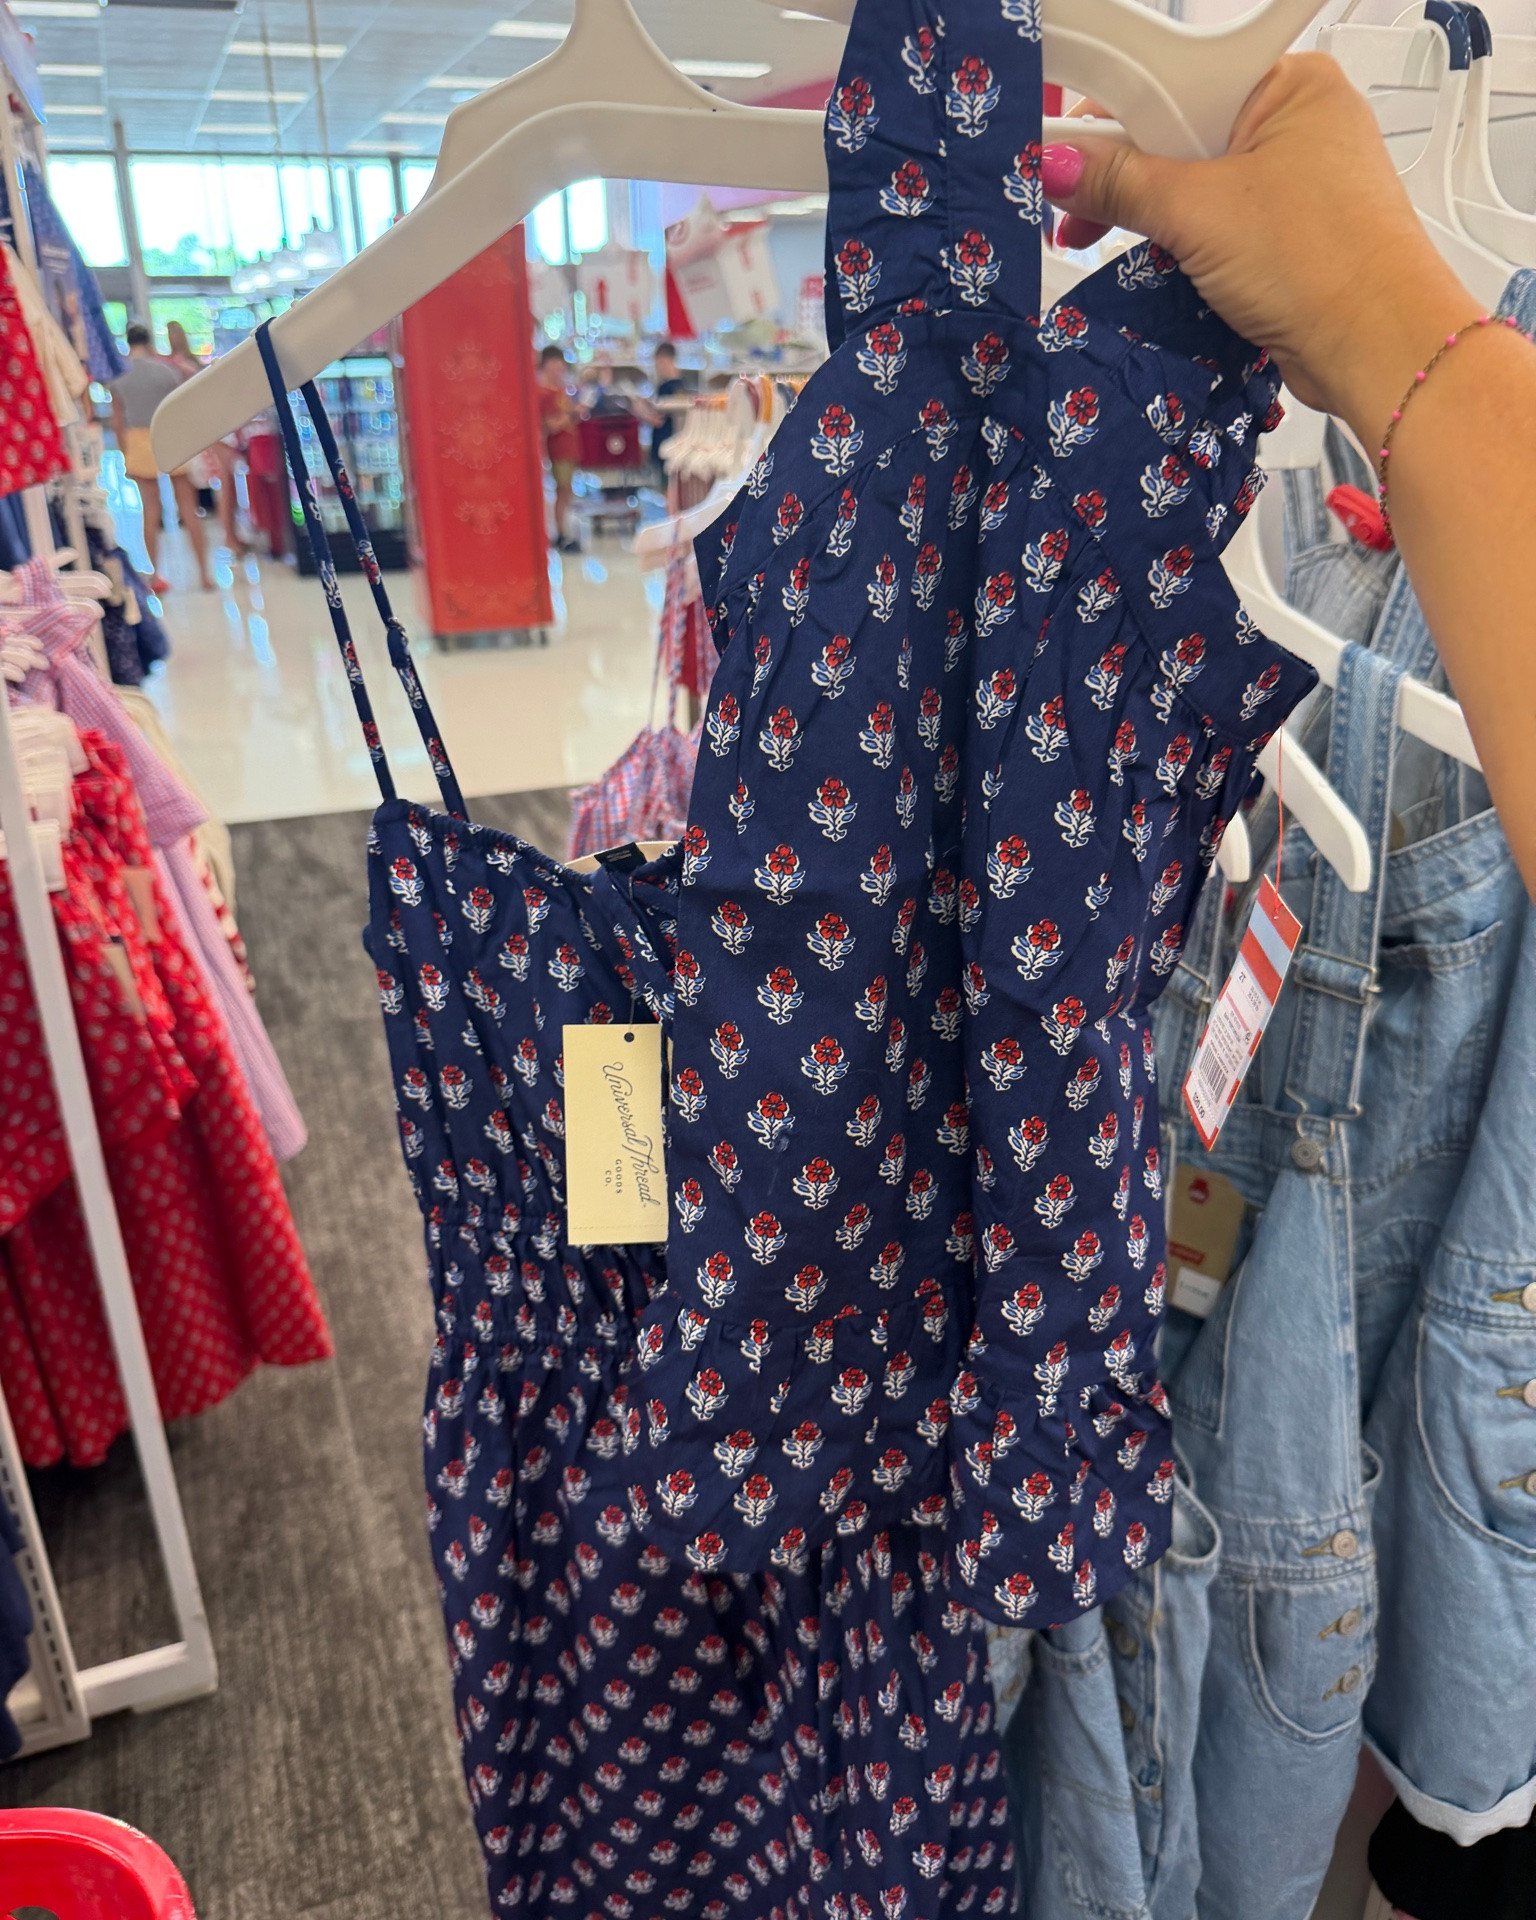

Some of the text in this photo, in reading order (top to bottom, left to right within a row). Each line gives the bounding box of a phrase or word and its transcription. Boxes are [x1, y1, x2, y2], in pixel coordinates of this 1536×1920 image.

[603, 1061, 661, 1204] Universal Thread
[615, 1158, 623, 1194] GOODS
